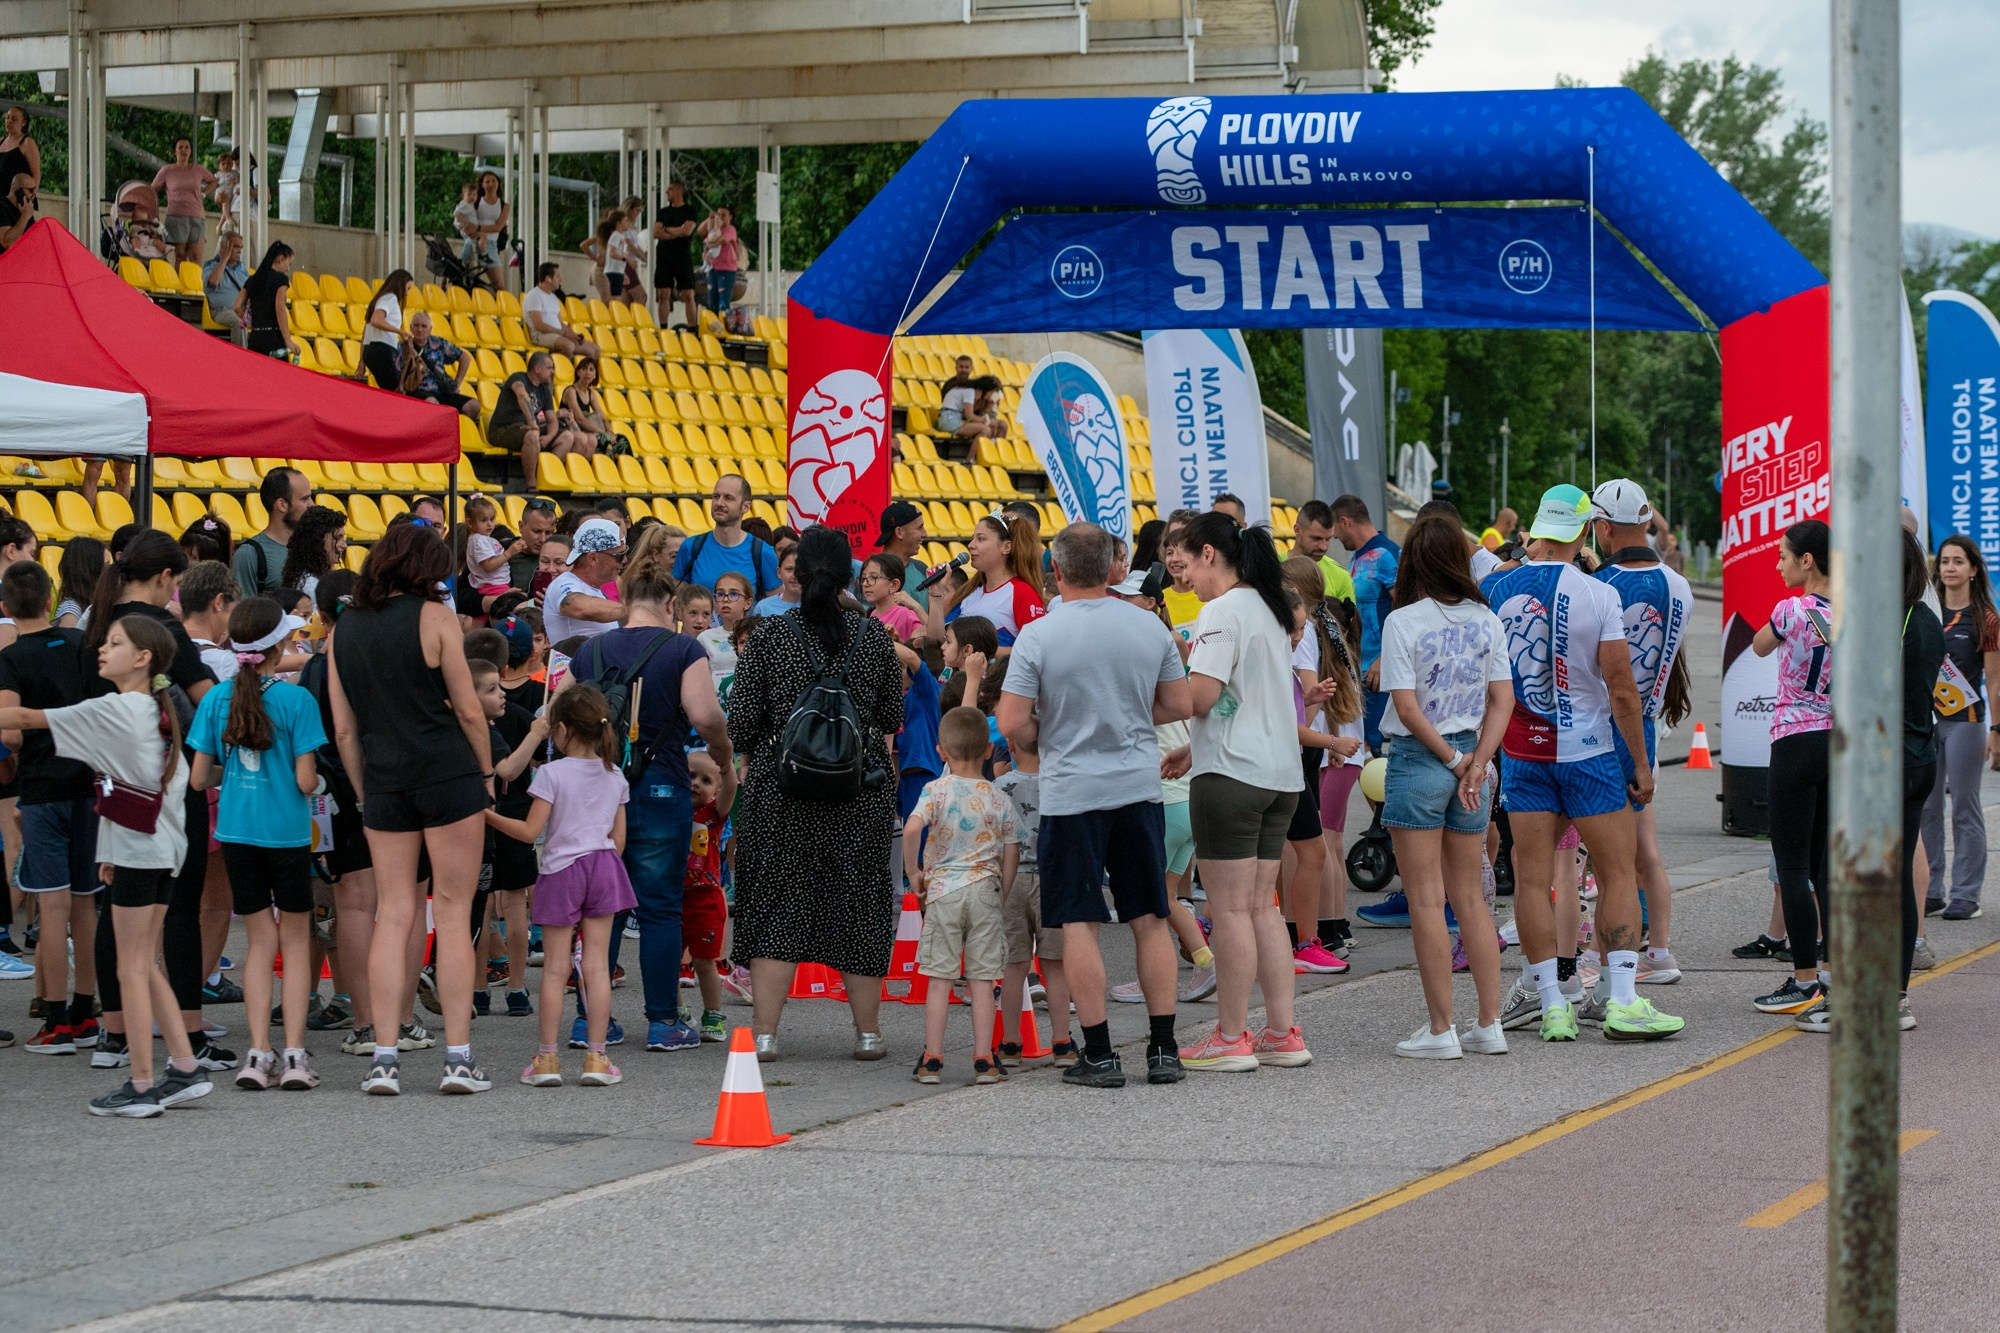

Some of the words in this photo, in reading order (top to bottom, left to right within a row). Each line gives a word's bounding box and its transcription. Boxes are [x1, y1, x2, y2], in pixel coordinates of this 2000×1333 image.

[1219, 111, 1362, 145] PLOVDIV
[1219, 154, 1312, 186] HILLS
[1319, 157, 1338, 168] IN
[1321, 171, 1413, 182] MARKOVO
[1060, 262, 1095, 279] P/H
[1171, 224, 1430, 311] START
[1508, 256, 1543, 274] P/H
[1740, 440, 1821, 506] STEP
[1419, 620, 1492, 663] STARS
[1555, 592, 1571, 657] MATTERS
[1653, 664, 1668, 698] STEP
[1664, 597, 1683, 663] MATTERS
[1555, 656, 1569, 691] STEP
[1554, 687, 1573, 728] EVERY
